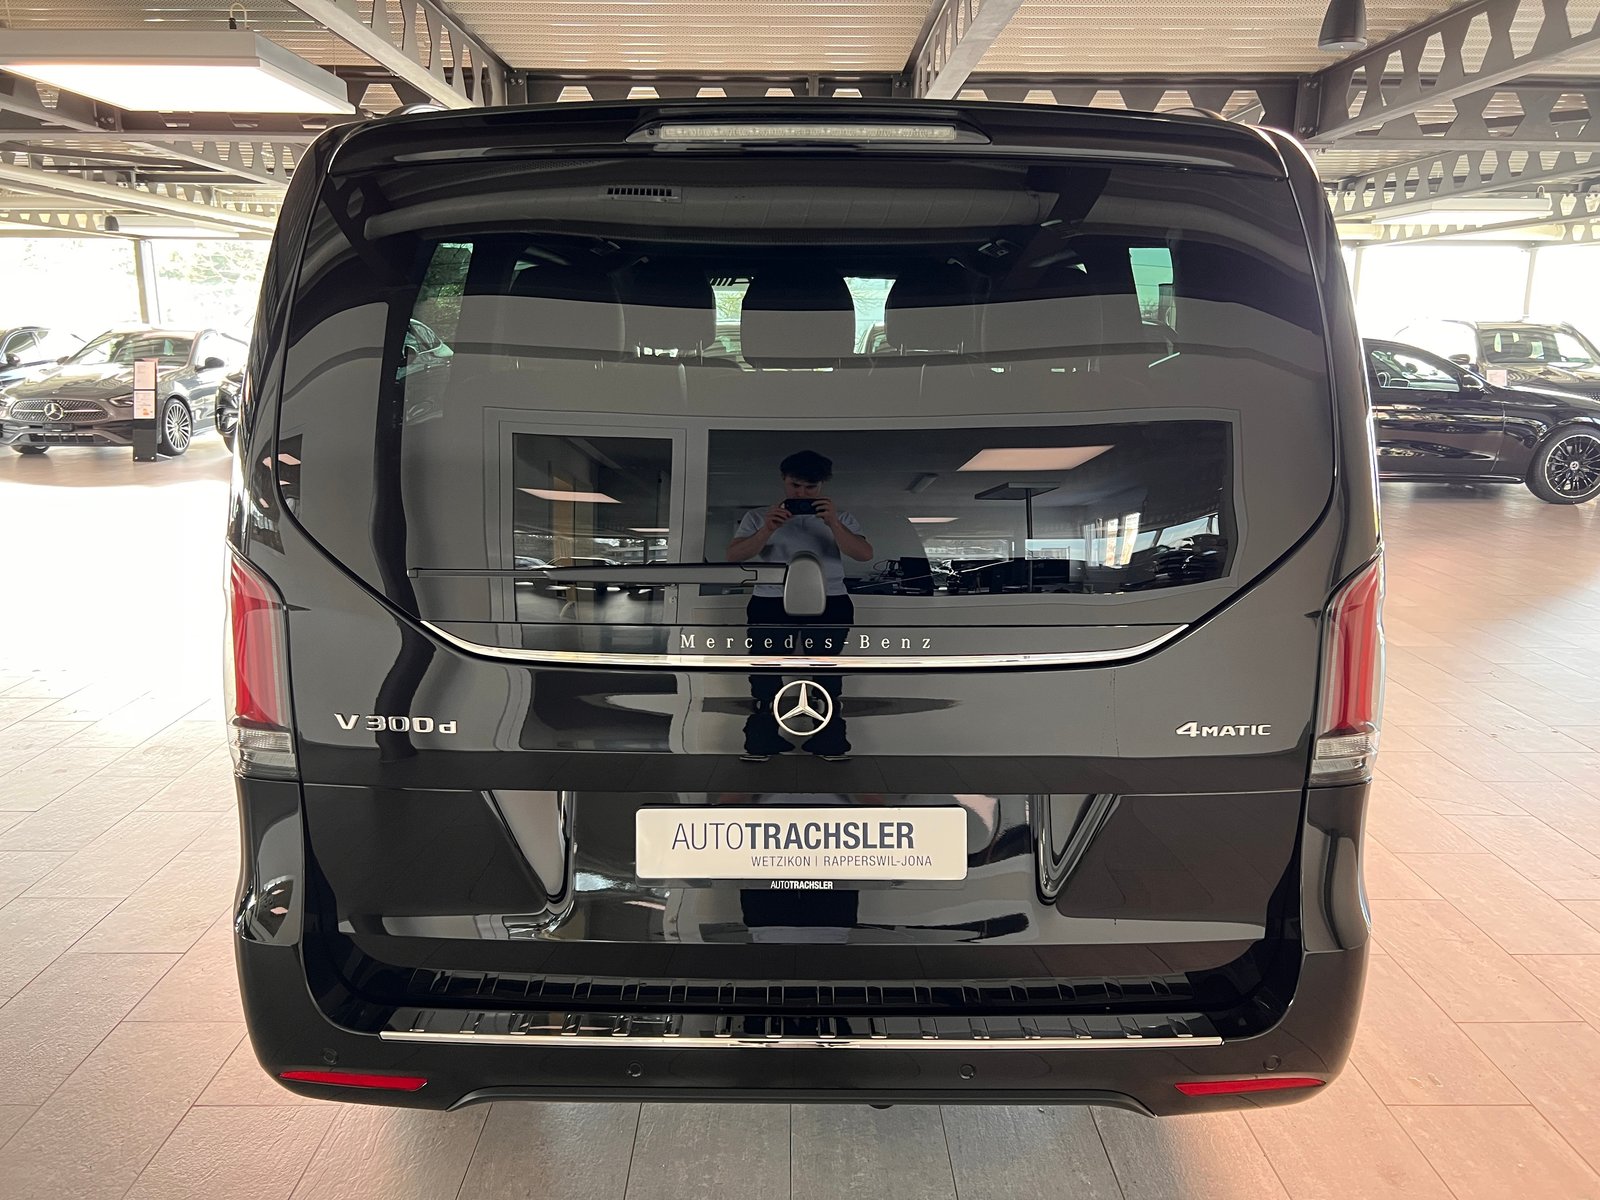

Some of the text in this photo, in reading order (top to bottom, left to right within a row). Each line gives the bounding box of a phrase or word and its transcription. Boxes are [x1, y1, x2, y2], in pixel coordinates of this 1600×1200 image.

[680, 635, 932, 649] Mercedes-Benz
[1175, 721, 1272, 738] 4MATIC
[672, 822, 914, 850] AUTOTRACHSLER
[751, 856, 932, 867] WETZIKON RAPPERSWIL-JONA
[770, 880, 833, 890] AUTOTRACHSLER
